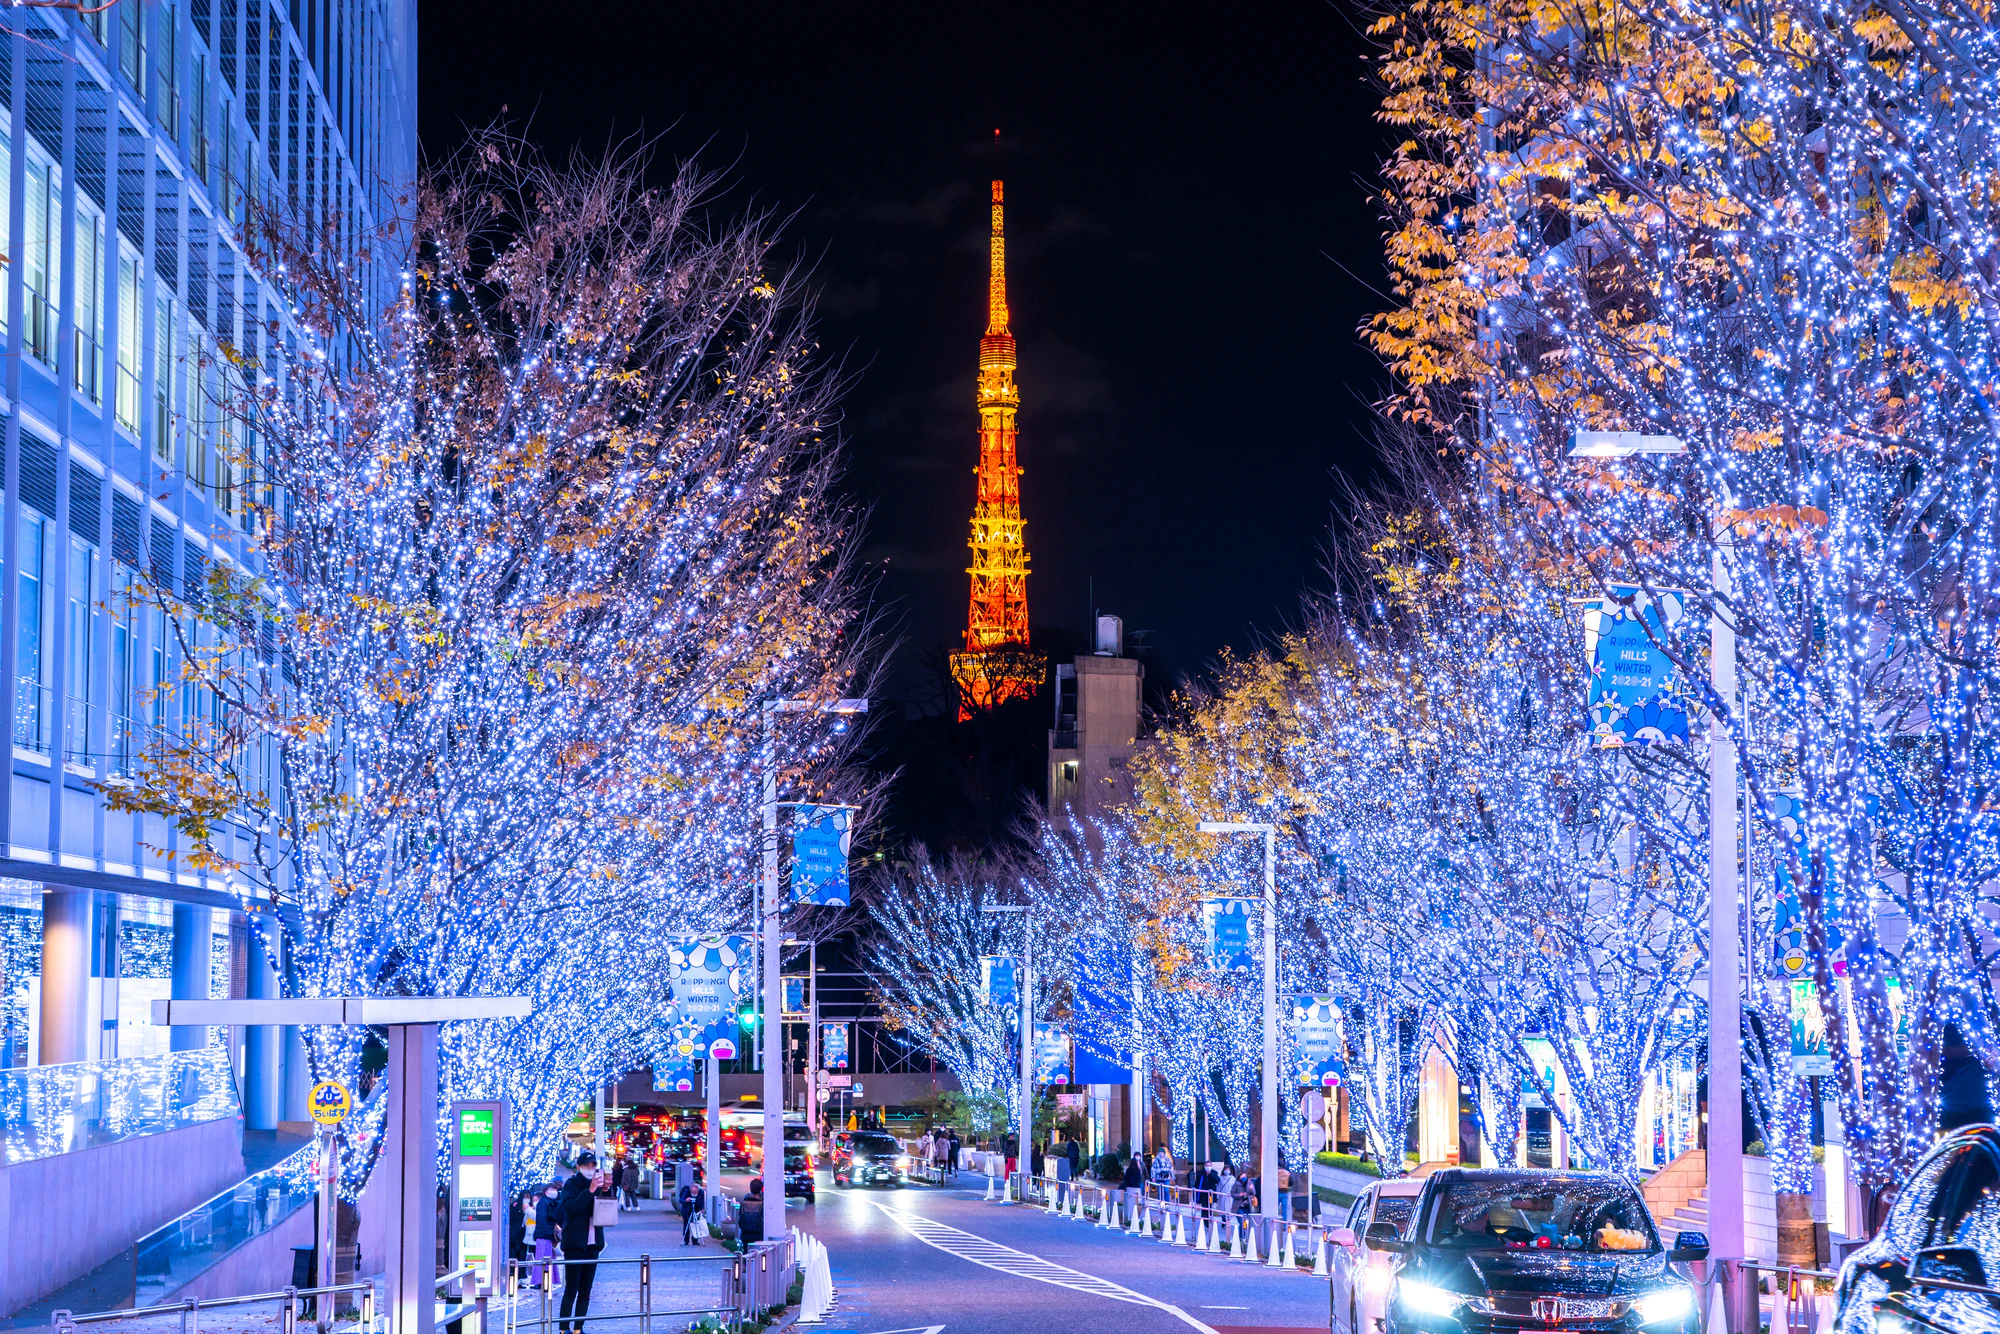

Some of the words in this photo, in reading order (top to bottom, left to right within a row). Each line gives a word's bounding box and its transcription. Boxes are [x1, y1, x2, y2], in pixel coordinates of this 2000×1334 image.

[1620, 650, 1647, 661] HILLS
[1614, 662, 1652, 674] WINTER
[1611, 674, 1652, 688] 2020-21
[801, 839, 837, 848] ROPPONGI
[809, 847, 828, 856] HILLS
[806, 855, 832, 864] WINTER
[805, 863, 833, 873] 2020-21
[680, 978, 726, 986] ROPPONGI
[691, 986, 715, 995] HILLS
[687, 995, 720, 1003] WINTER
[686, 1004, 721, 1013] 2020-21
[461, 1199, 492, 1208] 接近表示
